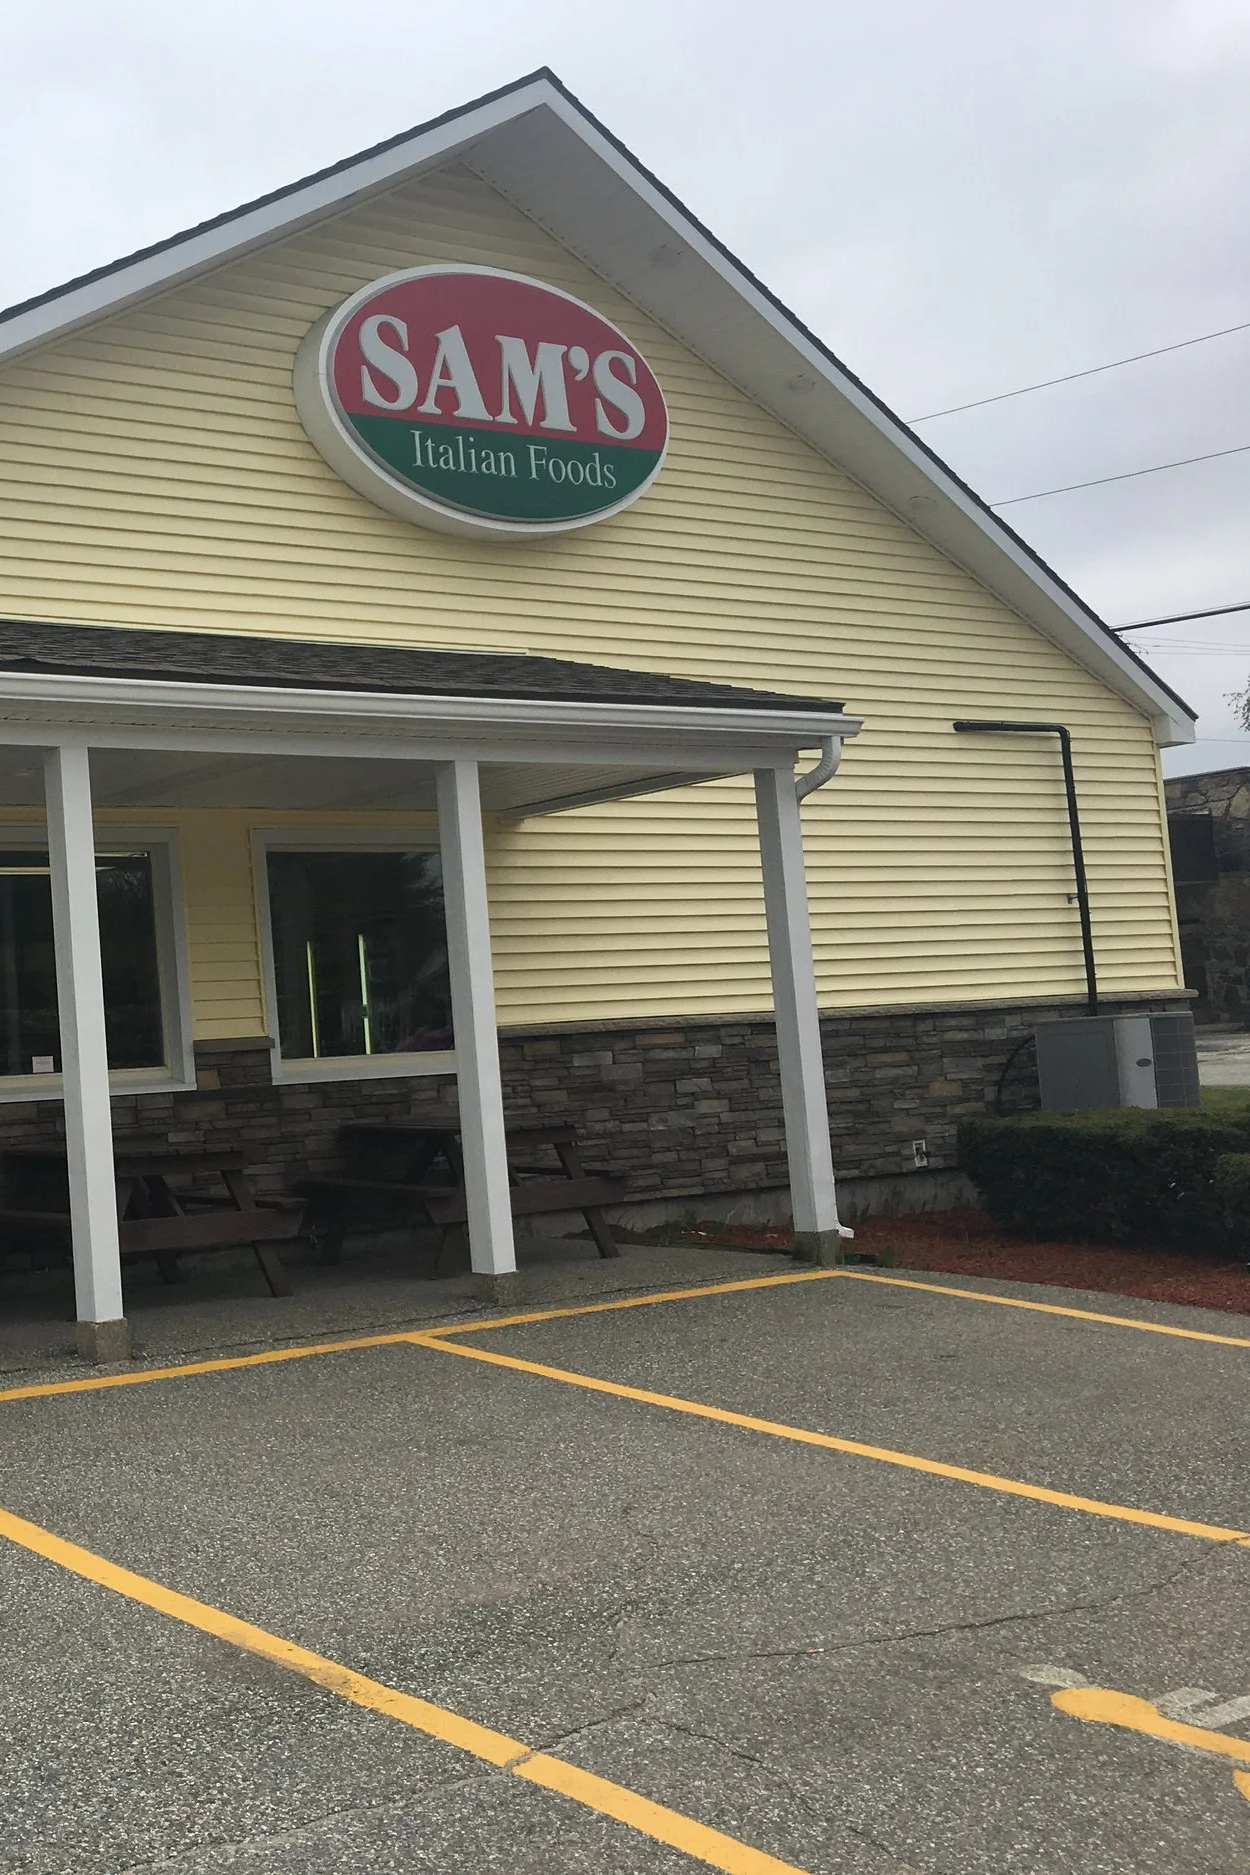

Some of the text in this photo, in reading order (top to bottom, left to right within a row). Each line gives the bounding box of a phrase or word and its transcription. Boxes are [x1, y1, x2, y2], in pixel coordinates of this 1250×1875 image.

[357, 314, 647, 441] SAM'S
[409, 429, 617, 489] Italian Foods
